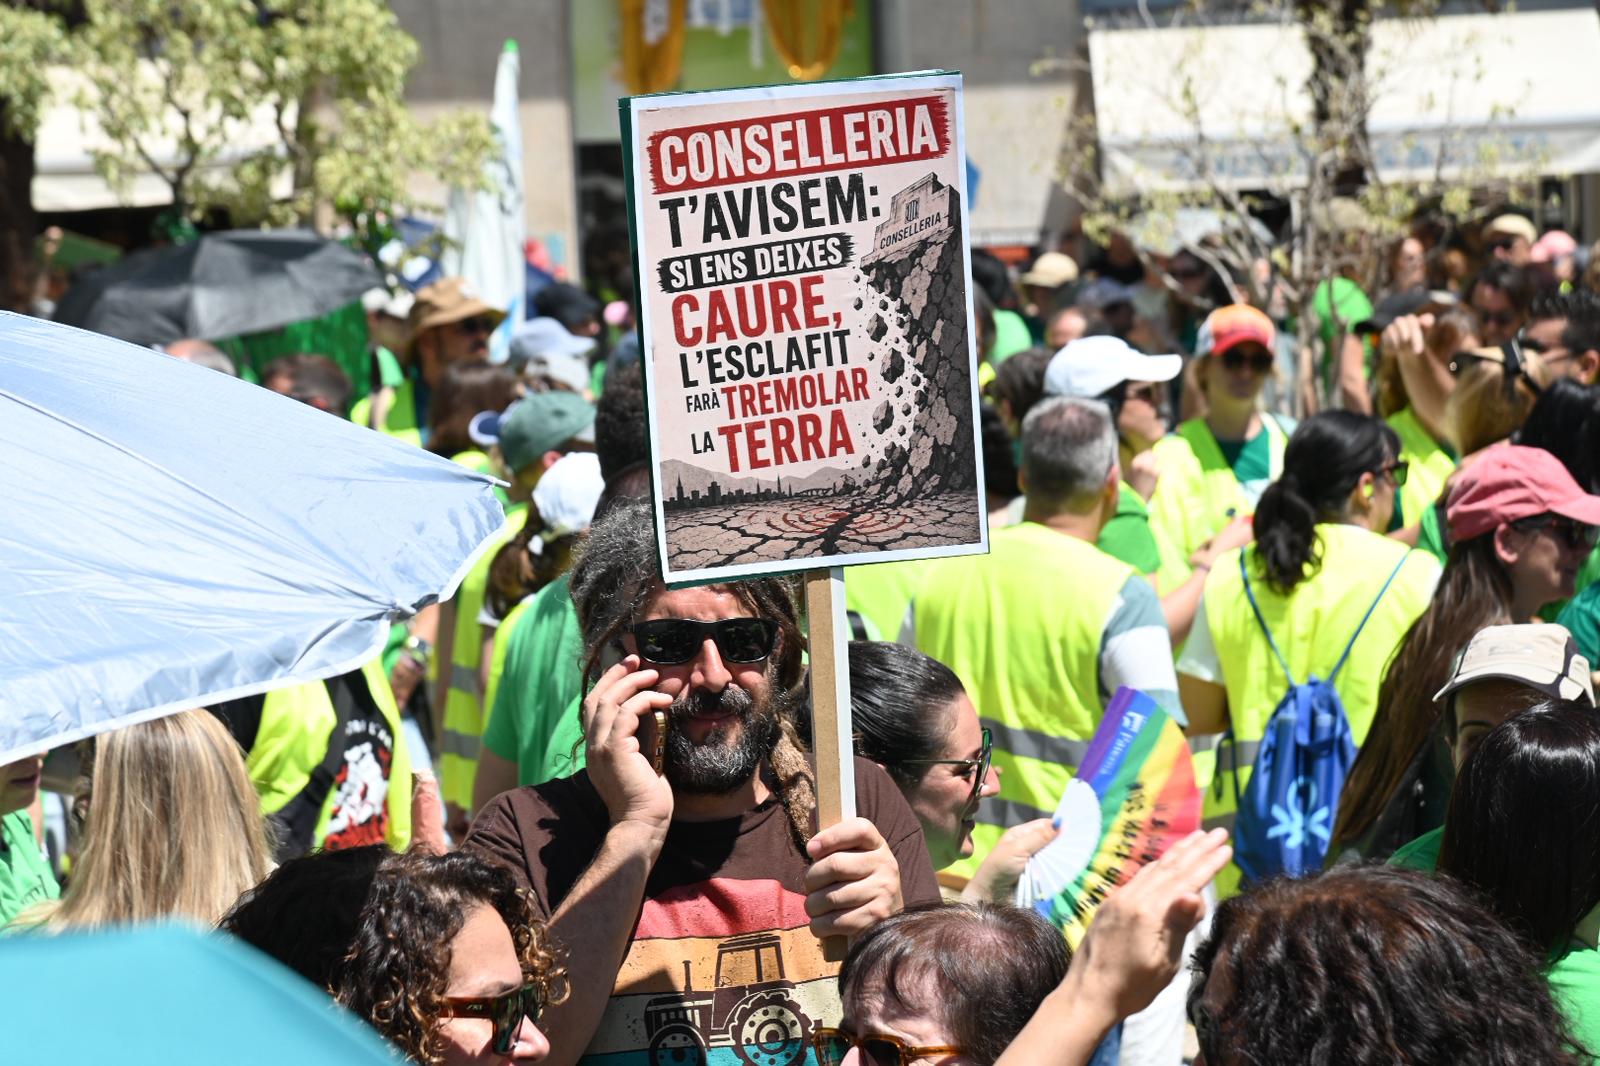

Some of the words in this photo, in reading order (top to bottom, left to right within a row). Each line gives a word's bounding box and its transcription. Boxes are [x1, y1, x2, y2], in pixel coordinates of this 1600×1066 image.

[658, 103, 940, 187] CONSELLERIA
[659, 172, 881, 248] T'AVISEM:
[880, 211, 941, 250] CONSELLERIA
[669, 258, 694, 289] SI
[700, 251, 748, 284] ENS
[755, 237, 843, 276] DEIXES
[671, 274, 842, 347] CAURE,
[679, 329, 850, 388] L'ESCLAFIT
[686, 388, 720, 413] FARÀ
[720, 367, 870, 420] TREMOLAR
[691, 431, 715, 454] LA
[717, 408, 855, 473] TERRA
